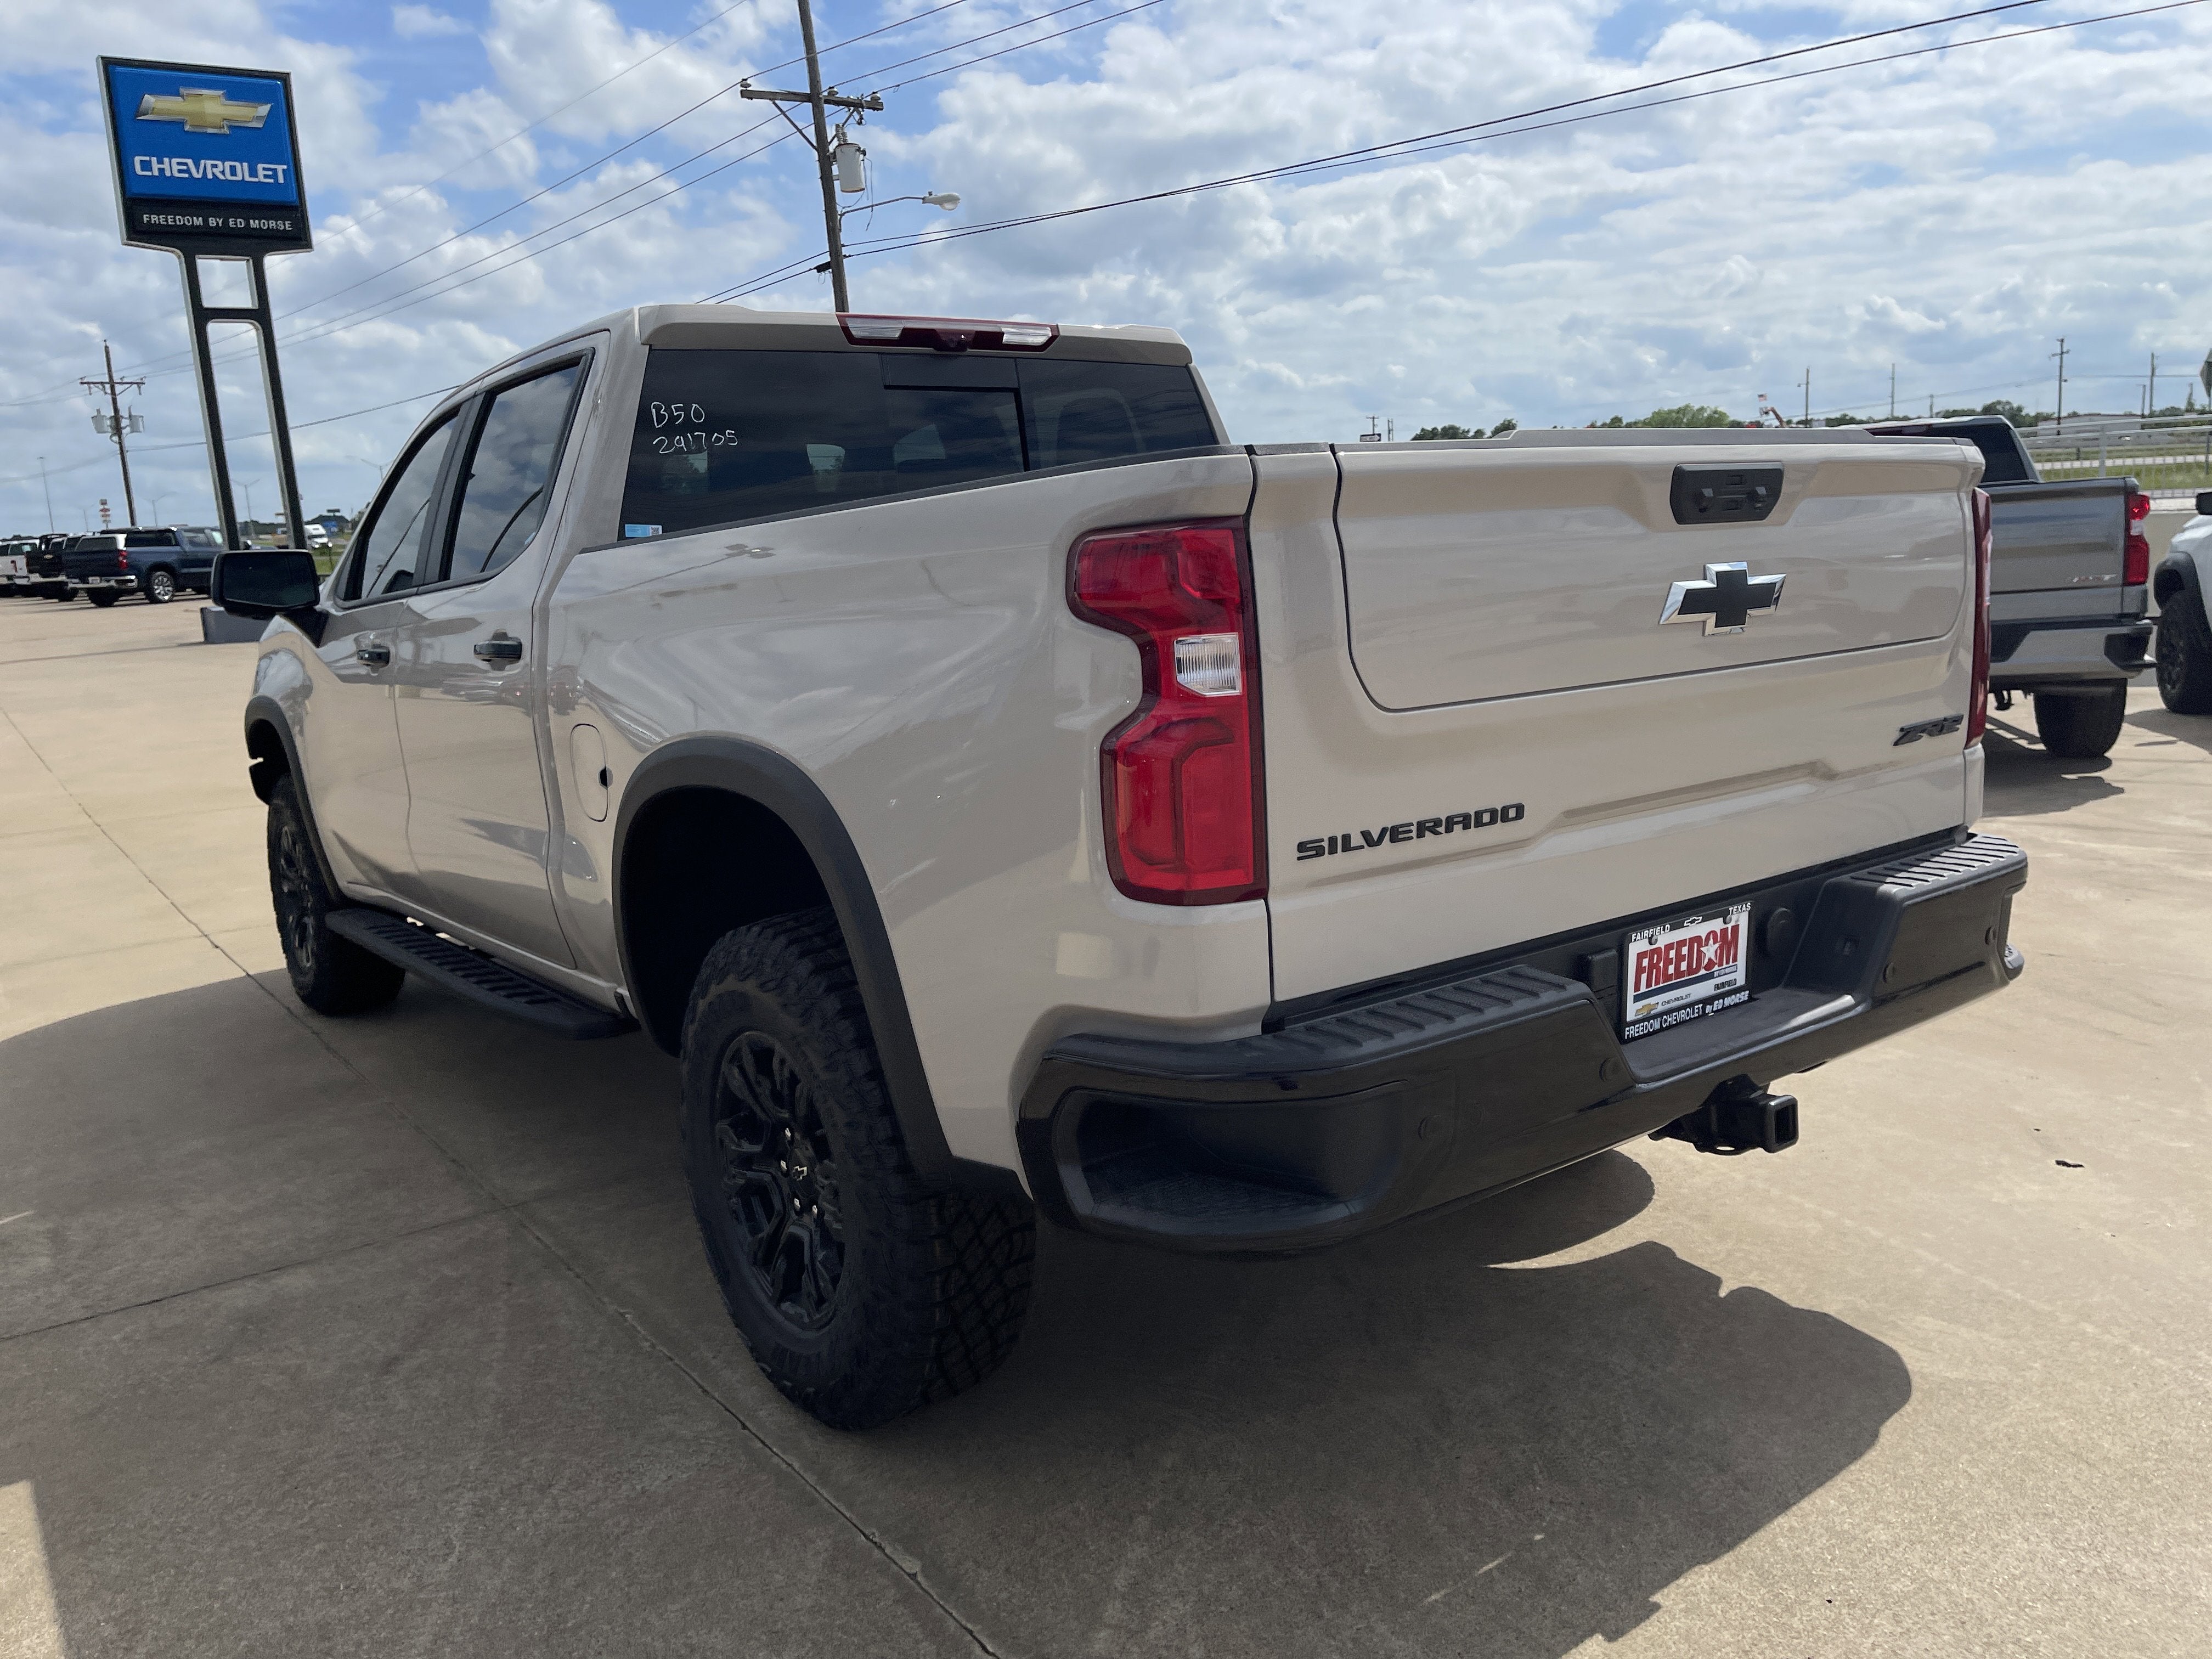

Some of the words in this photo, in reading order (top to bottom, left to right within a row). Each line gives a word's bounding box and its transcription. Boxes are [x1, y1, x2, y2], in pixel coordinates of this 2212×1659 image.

[133, 156, 287, 184] CHEVROLET
[143, 214, 203, 227] FREEDOM
[208, 217, 223, 228] BY
[229, 218, 245, 228] ED
[250, 219, 292, 230] MORSE
[651, 402, 705, 428] B50
[1297, 803, 1525, 861] SILVERADO
[1631, 924, 1670, 942] FAIRFIELD
[1728, 902, 1751, 916] TEXAS
[1633, 924, 1740, 994] FREEDOM
[1624, 1017, 1661, 1040] FREEDOM
[1662, 1003, 1703, 1028] CHEVROLET
[1713, 998, 1724, 1011] ED
[1723, 990, 1750, 1008] MORSE
[1661, 993, 1691, 1006] CHEVROLET
